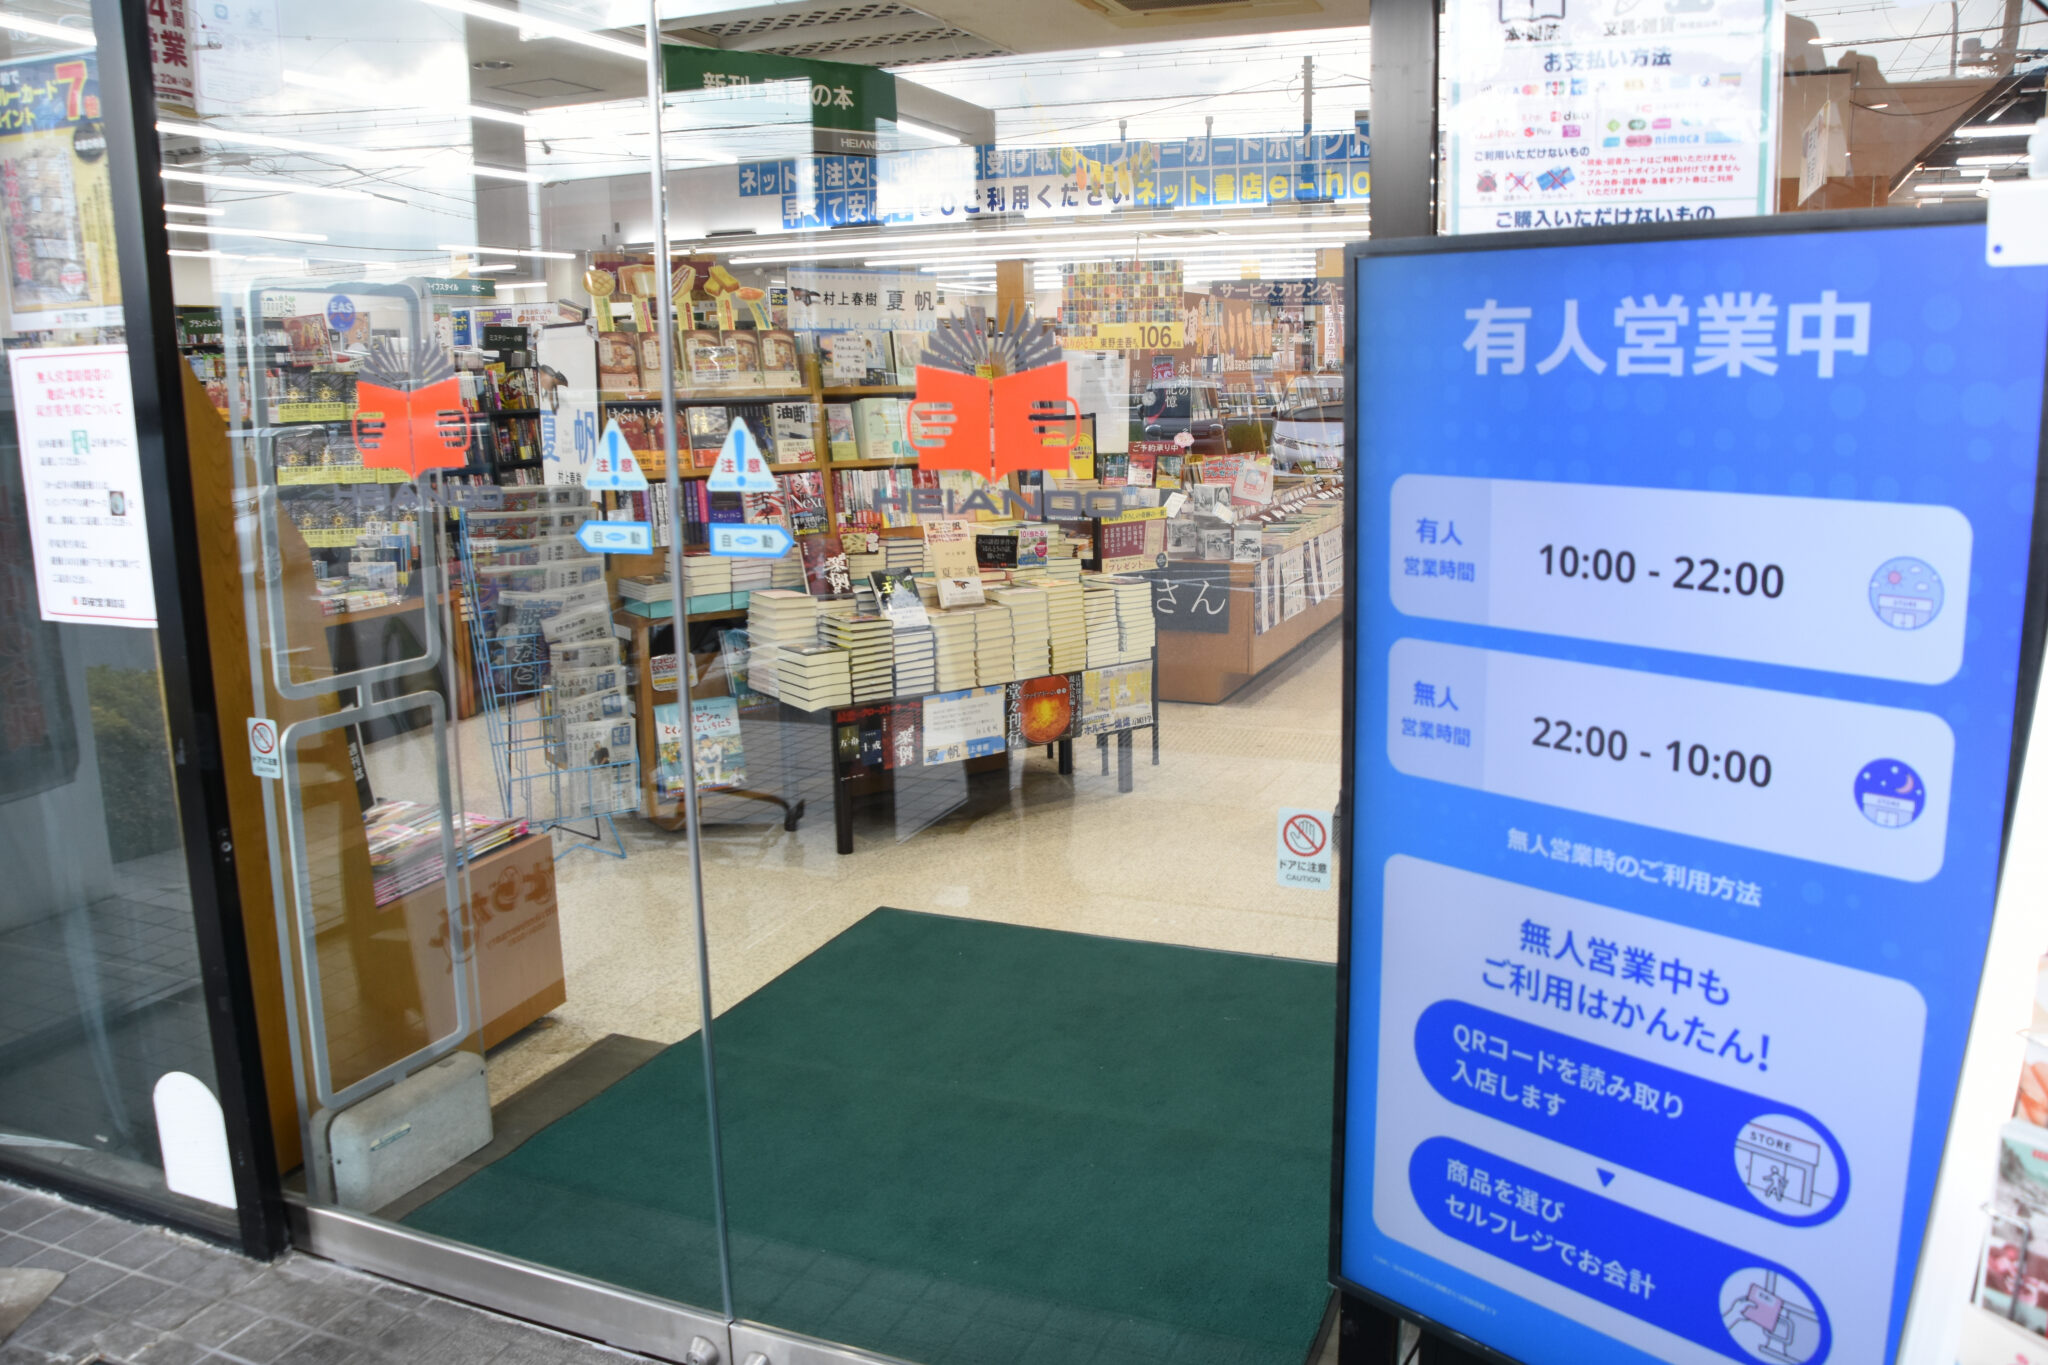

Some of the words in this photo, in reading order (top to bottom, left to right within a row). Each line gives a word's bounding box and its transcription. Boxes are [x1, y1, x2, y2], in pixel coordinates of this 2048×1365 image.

[1544, 47, 1672, 73] お支払い方法
[841, 137, 892, 151] HEIANDO
[1655, 132, 1700, 145] nimoca
[330, 301, 354, 313] EAS
[823, 291, 877, 307] 村上春樹
[1139, 325, 1172, 348] 106
[1463, 290, 1873, 379] 有人営業中
[872, 488, 1124, 517] HEIANDO
[1415, 517, 1463, 546] 有人
[1403, 556, 1476, 583] 営業時間
[1539, 543, 1637, 583] 10:00
[1673, 556, 1786, 599] 22:00
[1156, 578, 1226, 614] さん
[1412, 681, 1460, 711] 無人
[1400, 717, 1472, 748] 営業時間
[1531, 715, 1629, 763] 22:00
[1666, 740, 1773, 788] 10:00
[1280, 860, 1328, 874] ドアに注意
[1286, 874, 1321, 883] CAUTION
[1507, 828, 1762, 907] 無人営業時のご利用方法
[1519, 918, 1731, 1007] 無人営業中も
[1482, 956, 1772, 1073] ご利用はかんたん!
[1452, 1022, 1685, 1120] QRコードを読み取り
[1451, 1059, 1567, 1117] 入店します
[1749, 1129, 1793, 1154] STORE
[1446, 1158, 1565, 1224] 商品を選び
[1445, 1194, 1656, 1300] セルフレジでお会計
